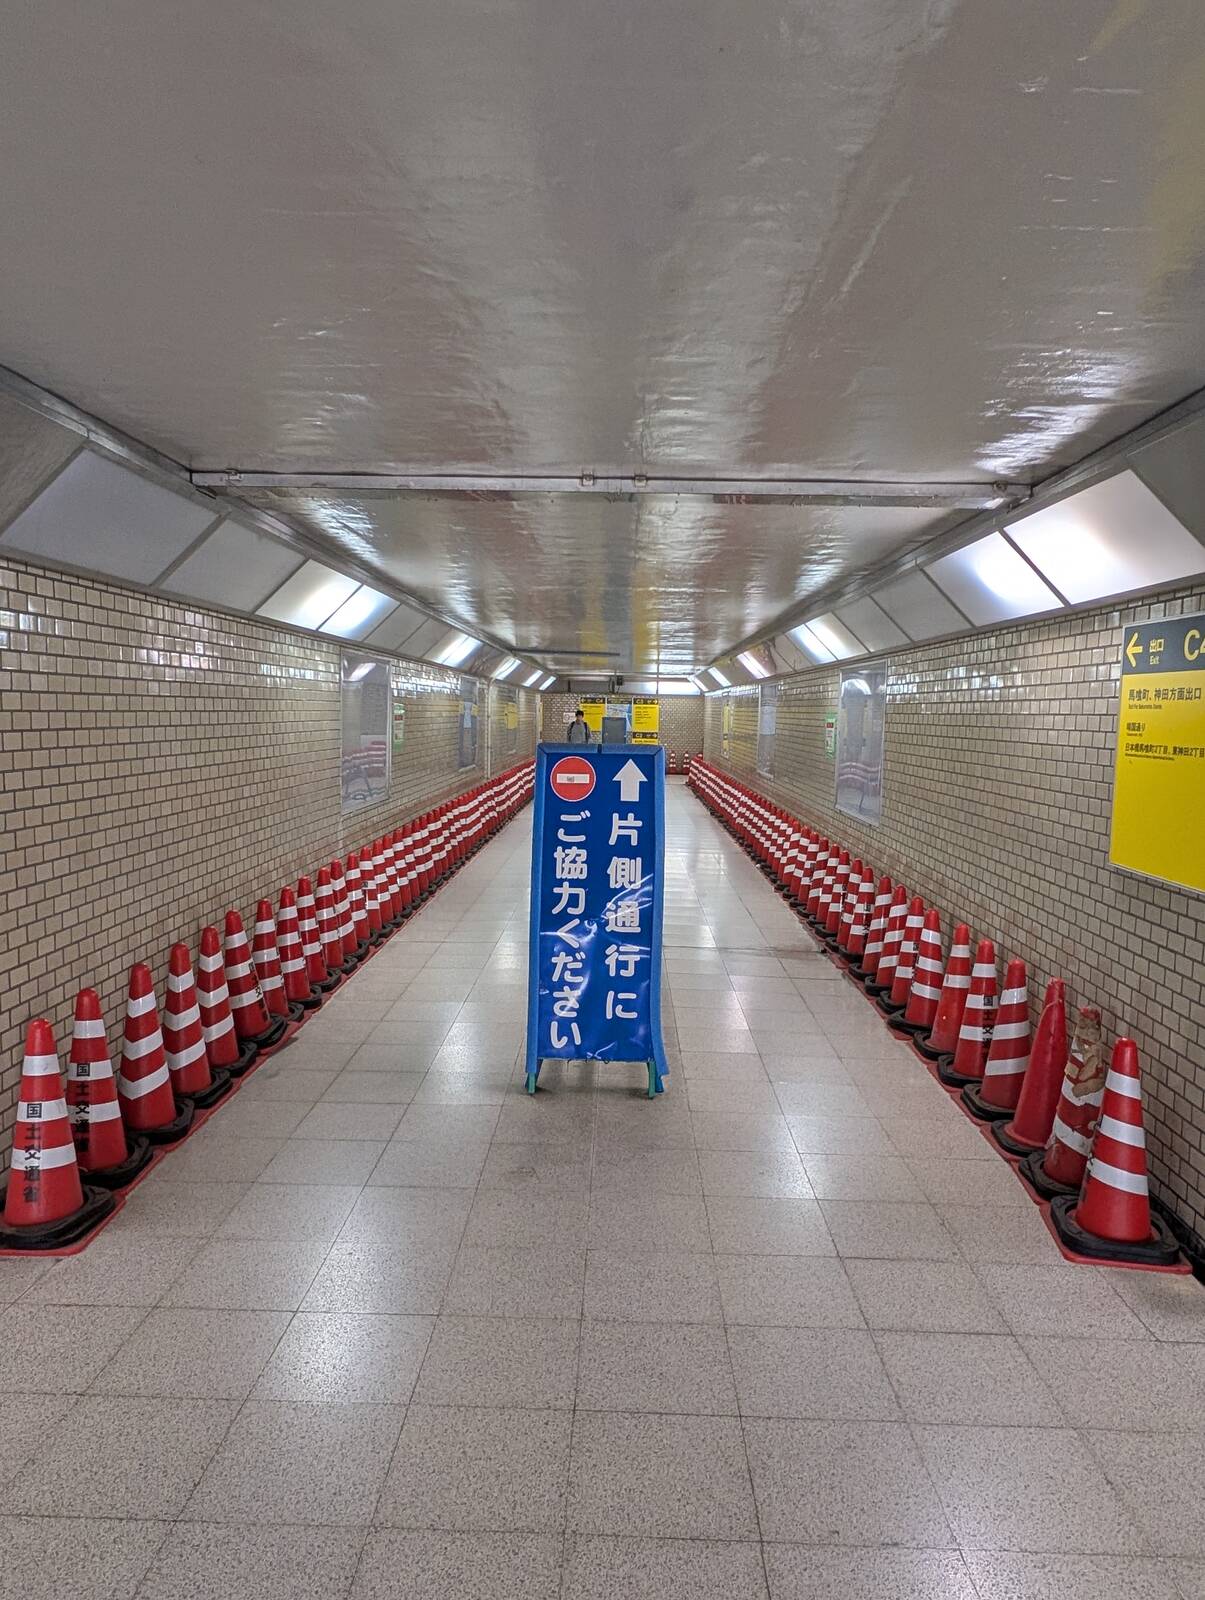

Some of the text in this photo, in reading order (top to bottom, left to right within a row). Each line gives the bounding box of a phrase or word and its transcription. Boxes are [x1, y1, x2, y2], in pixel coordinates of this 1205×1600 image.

[1149, 639, 1165, 652] 出口
[550, 810, 590, 1049] ご協力ください
[605, 813, 643, 1019] 片側通行に
